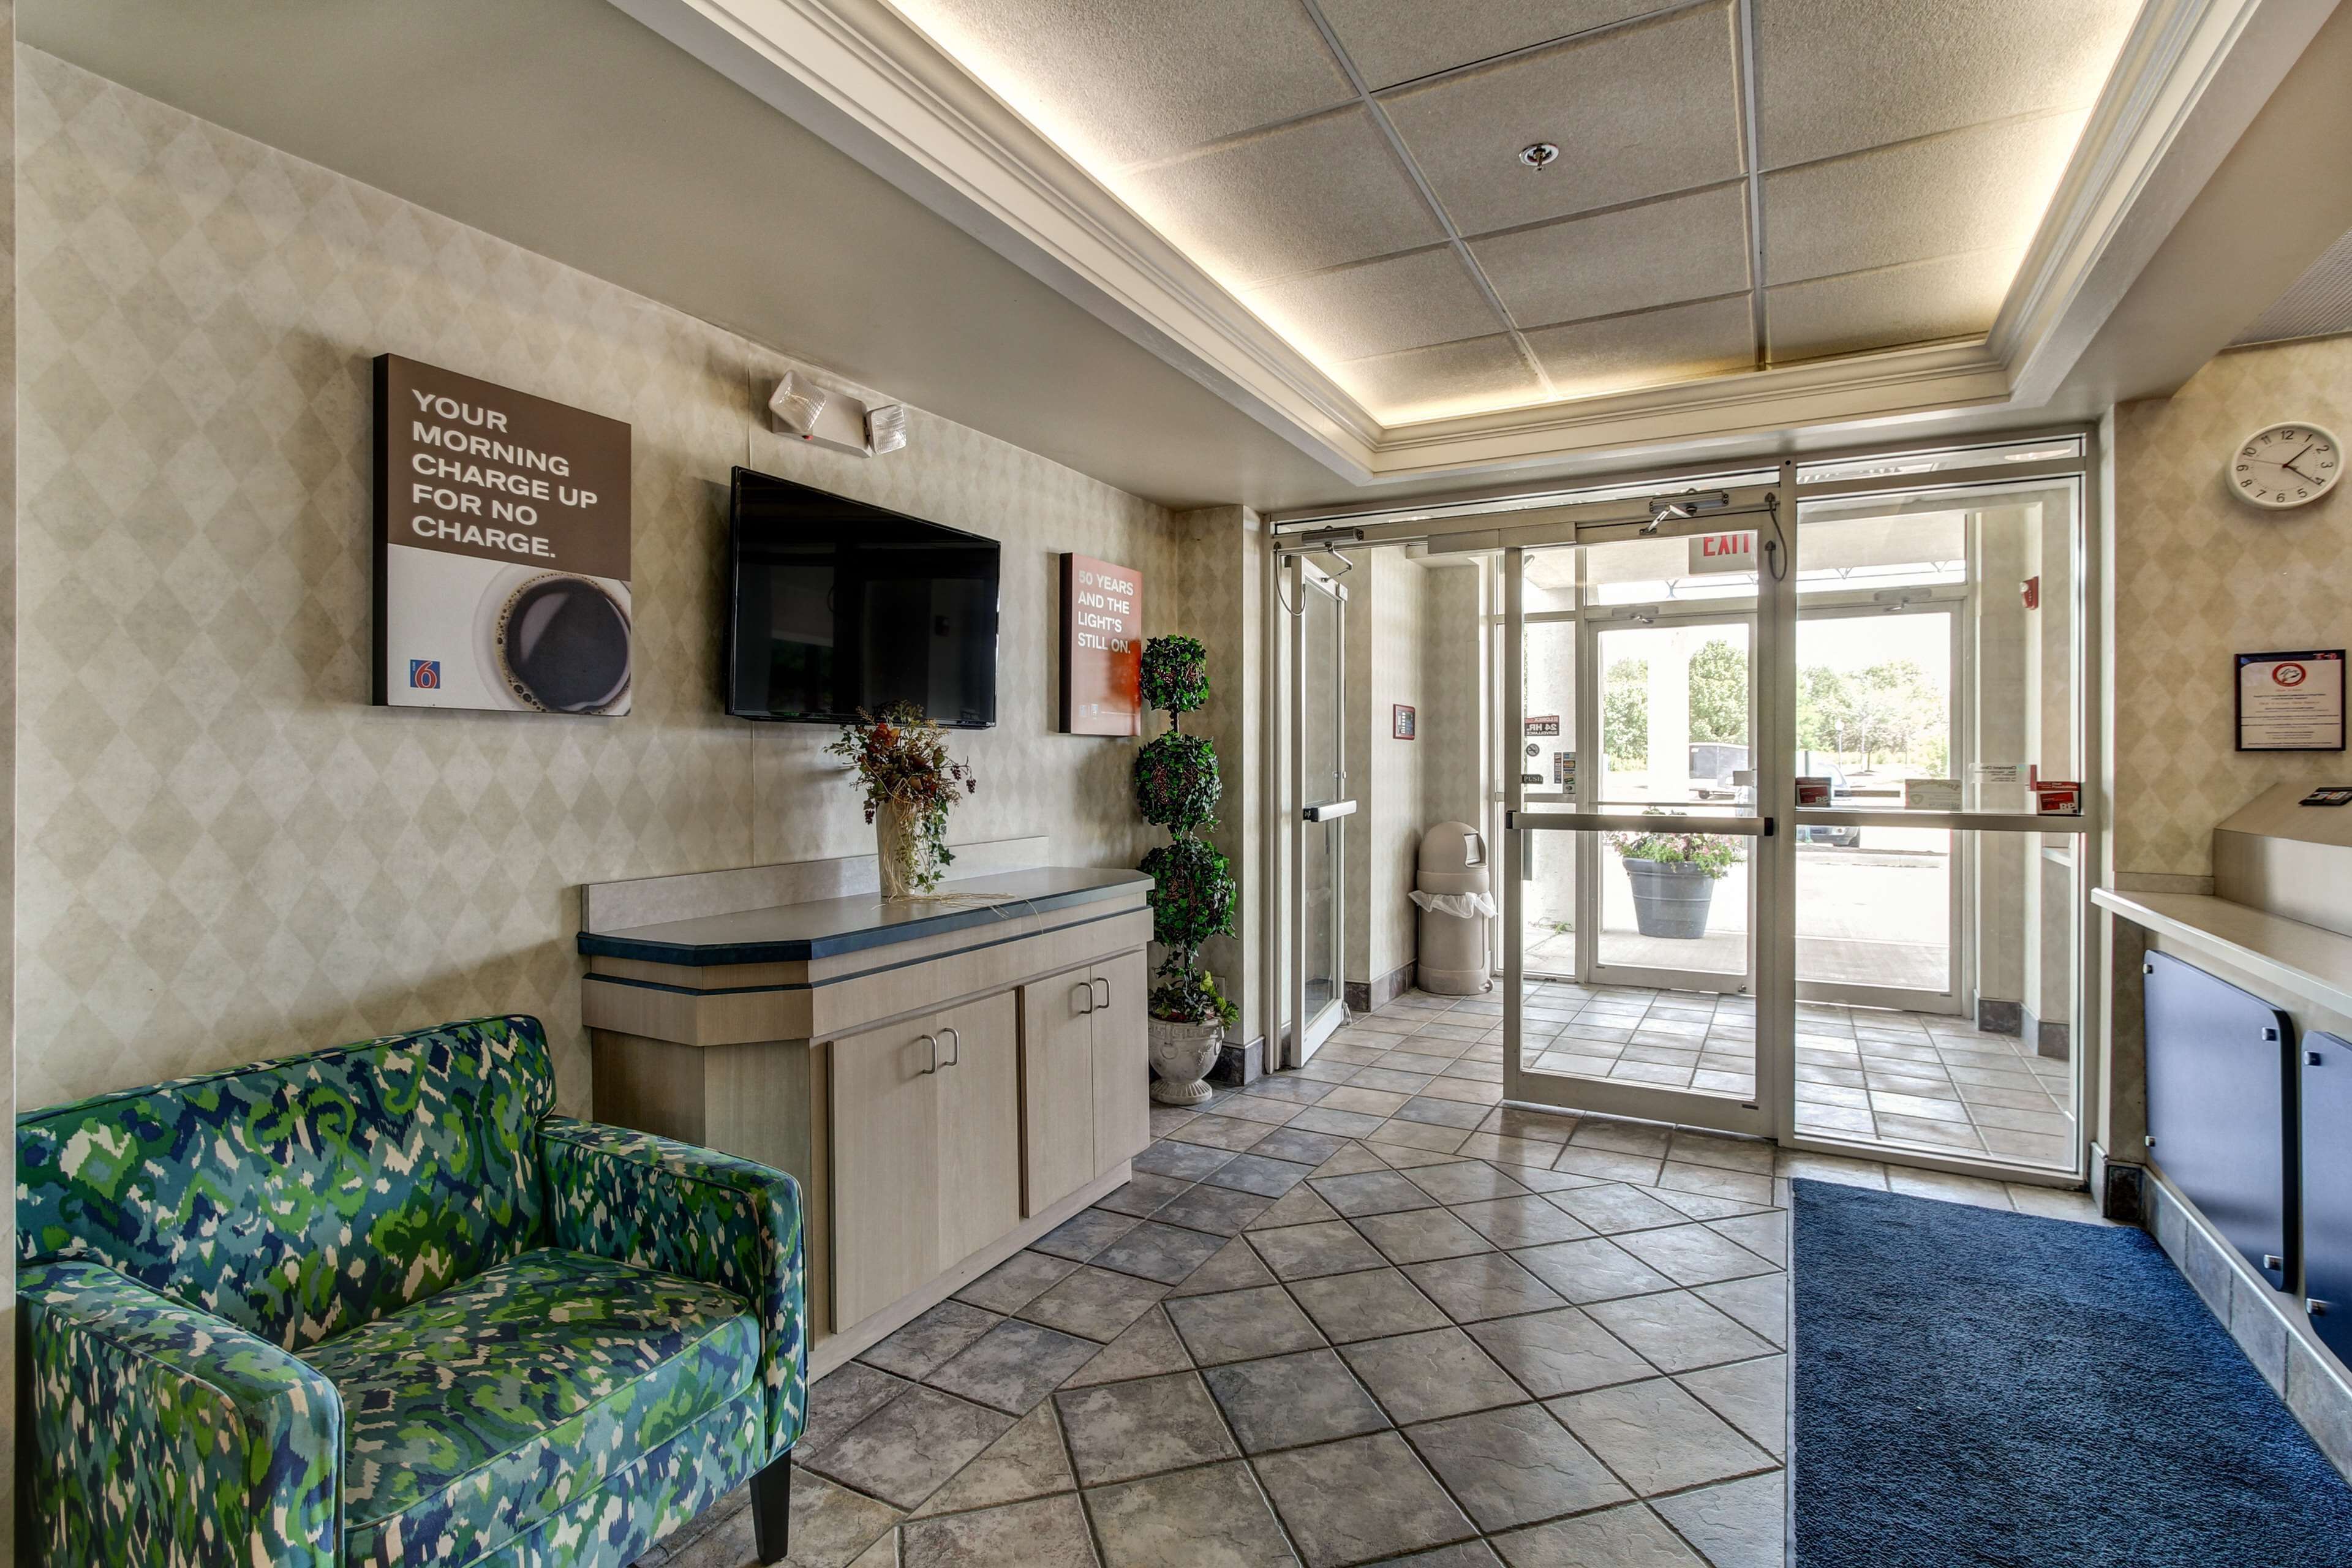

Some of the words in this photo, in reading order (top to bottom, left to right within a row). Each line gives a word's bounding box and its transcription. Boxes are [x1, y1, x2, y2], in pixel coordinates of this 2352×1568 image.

[412, 388, 508, 434] YOUR
[2261, 435, 2272, 445] 11
[2280, 430, 2295, 440] 12
[2304, 434, 2313, 442] 1
[413, 420, 569, 477] MORNING
[2242, 447, 2257, 457] 10
[2316, 445, 2330, 454] 2
[412, 453, 550, 501] CHARGE
[559, 486, 598, 508] UP
[2240, 479, 2253, 488] 8
[2315, 477, 2326, 486] 4
[2255, 489, 2267, 498] 7
[2276, 493, 2285, 503] 6
[2297, 488, 2308, 498] 5
[412, 483, 482, 516] FOR
[492, 500, 538, 526] NO
[412, 516, 556, 557] CHARGE.
[1078, 570, 1093, 586] 50
[1096, 574, 1134, 596] YEARS
[1078, 591, 1104, 608] AND
[1107, 597, 1130, 615] THE
[1078, 611, 1123, 633] LIGHT'S
[1078, 632, 1108, 651] STILL
[1111, 638, 1131, 655] ON.
[415, 661, 437, 689] 6
